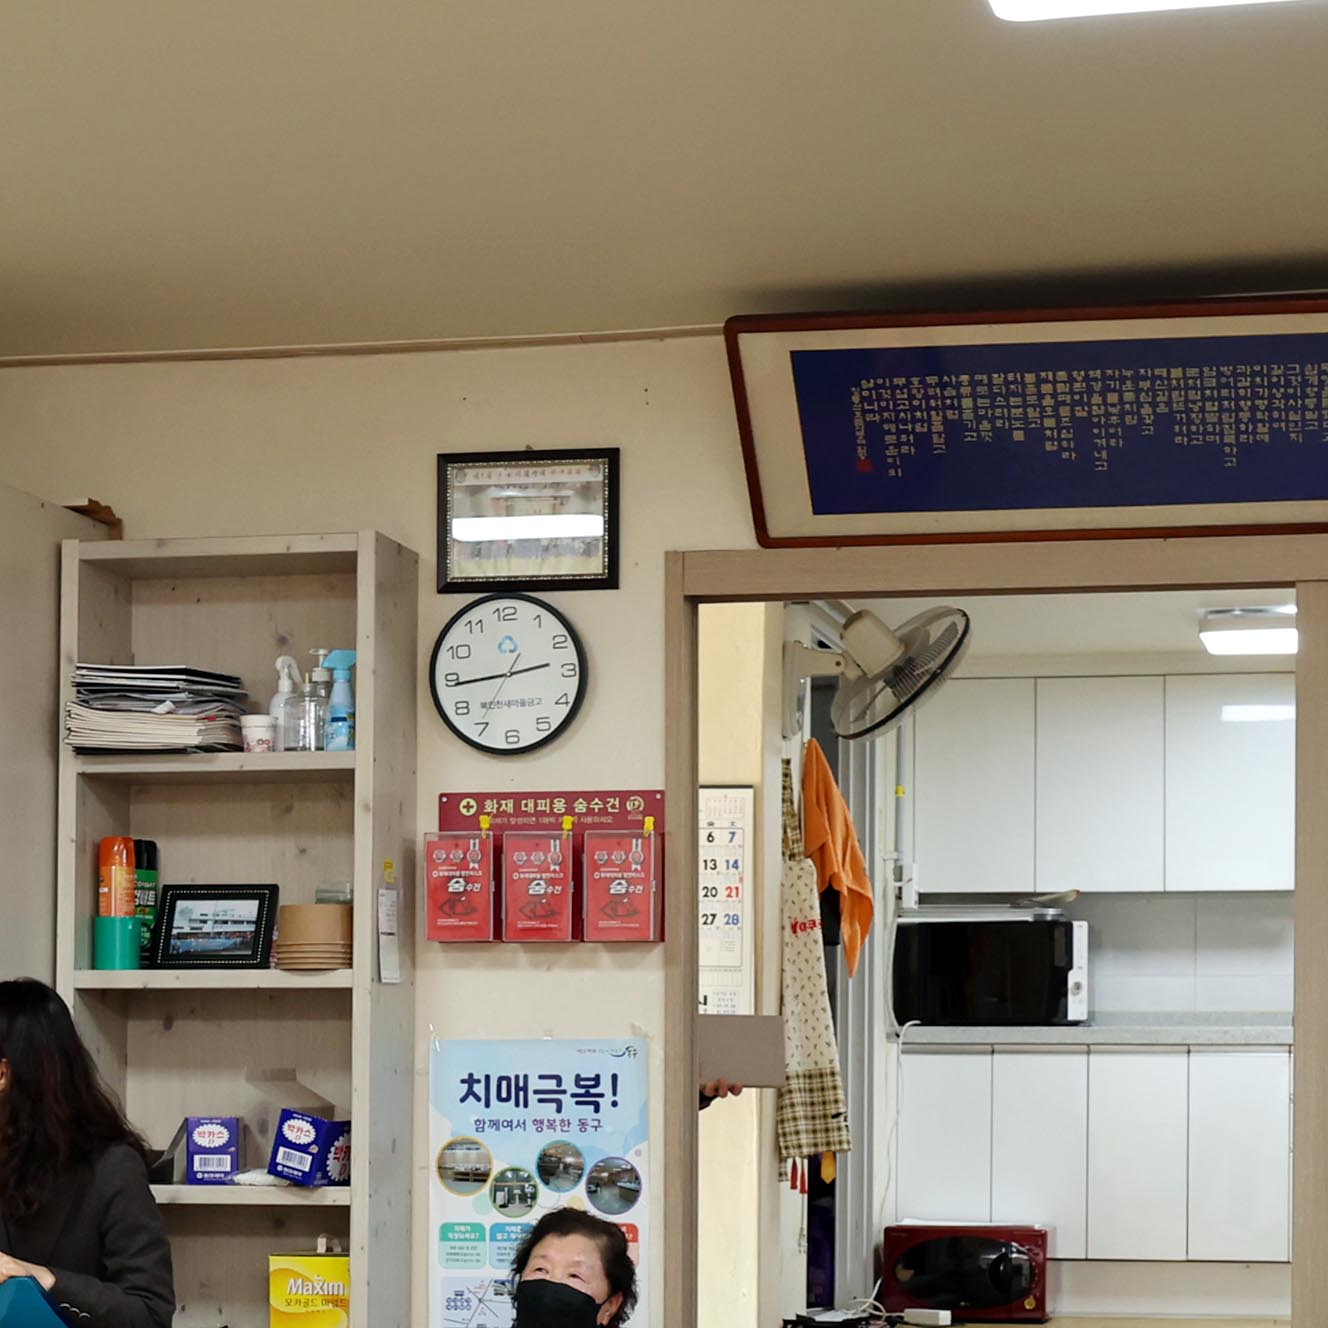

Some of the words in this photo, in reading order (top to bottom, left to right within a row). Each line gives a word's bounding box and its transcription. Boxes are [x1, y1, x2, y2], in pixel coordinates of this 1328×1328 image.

[492, 606, 518, 621] 12
[464, 619, 485, 634] 11
[533, 614, 543, 629] 1
[552, 635, 568, 649] 2
[446, 644, 471, 659] 10
[561, 663, 577, 678] 3
[444, 673, 460, 687] 9
[455, 700, 470, 715] 8
[554, 693, 570, 707] 4
[474, 722, 490, 737] 7
[536, 717, 552, 732] 5
[505, 729, 520, 744] 6
[483, 798, 515, 814] 화재
[521, 797, 568, 814] 대피용
[573, 796, 620, 813] 숨수건
[707, 831, 715, 843] 6
[728, 831, 736, 843] 7
[703, 859, 718, 872] 13
[724, 858, 739, 871] 14
[701, 886, 718, 898] 20
[725, 885, 740, 898] 21
[701, 913, 718, 926] 27
[723, 913, 739, 925] 28
[459, 1072, 619, 1114] 치매극복!
[287, 1124, 313, 1138] 박카스
[474, 1119, 526, 1132] 함께여서
[532, 1118, 572, 1132] 행복한
[577, 1118, 603, 1132] 동구
[197, 1130, 224, 1139] 박카스
[288, 1278, 344, 1295] Maxim
[285, 1298, 318, 1307] 모카골드
[321, 1298, 347, 1307] 마일드
